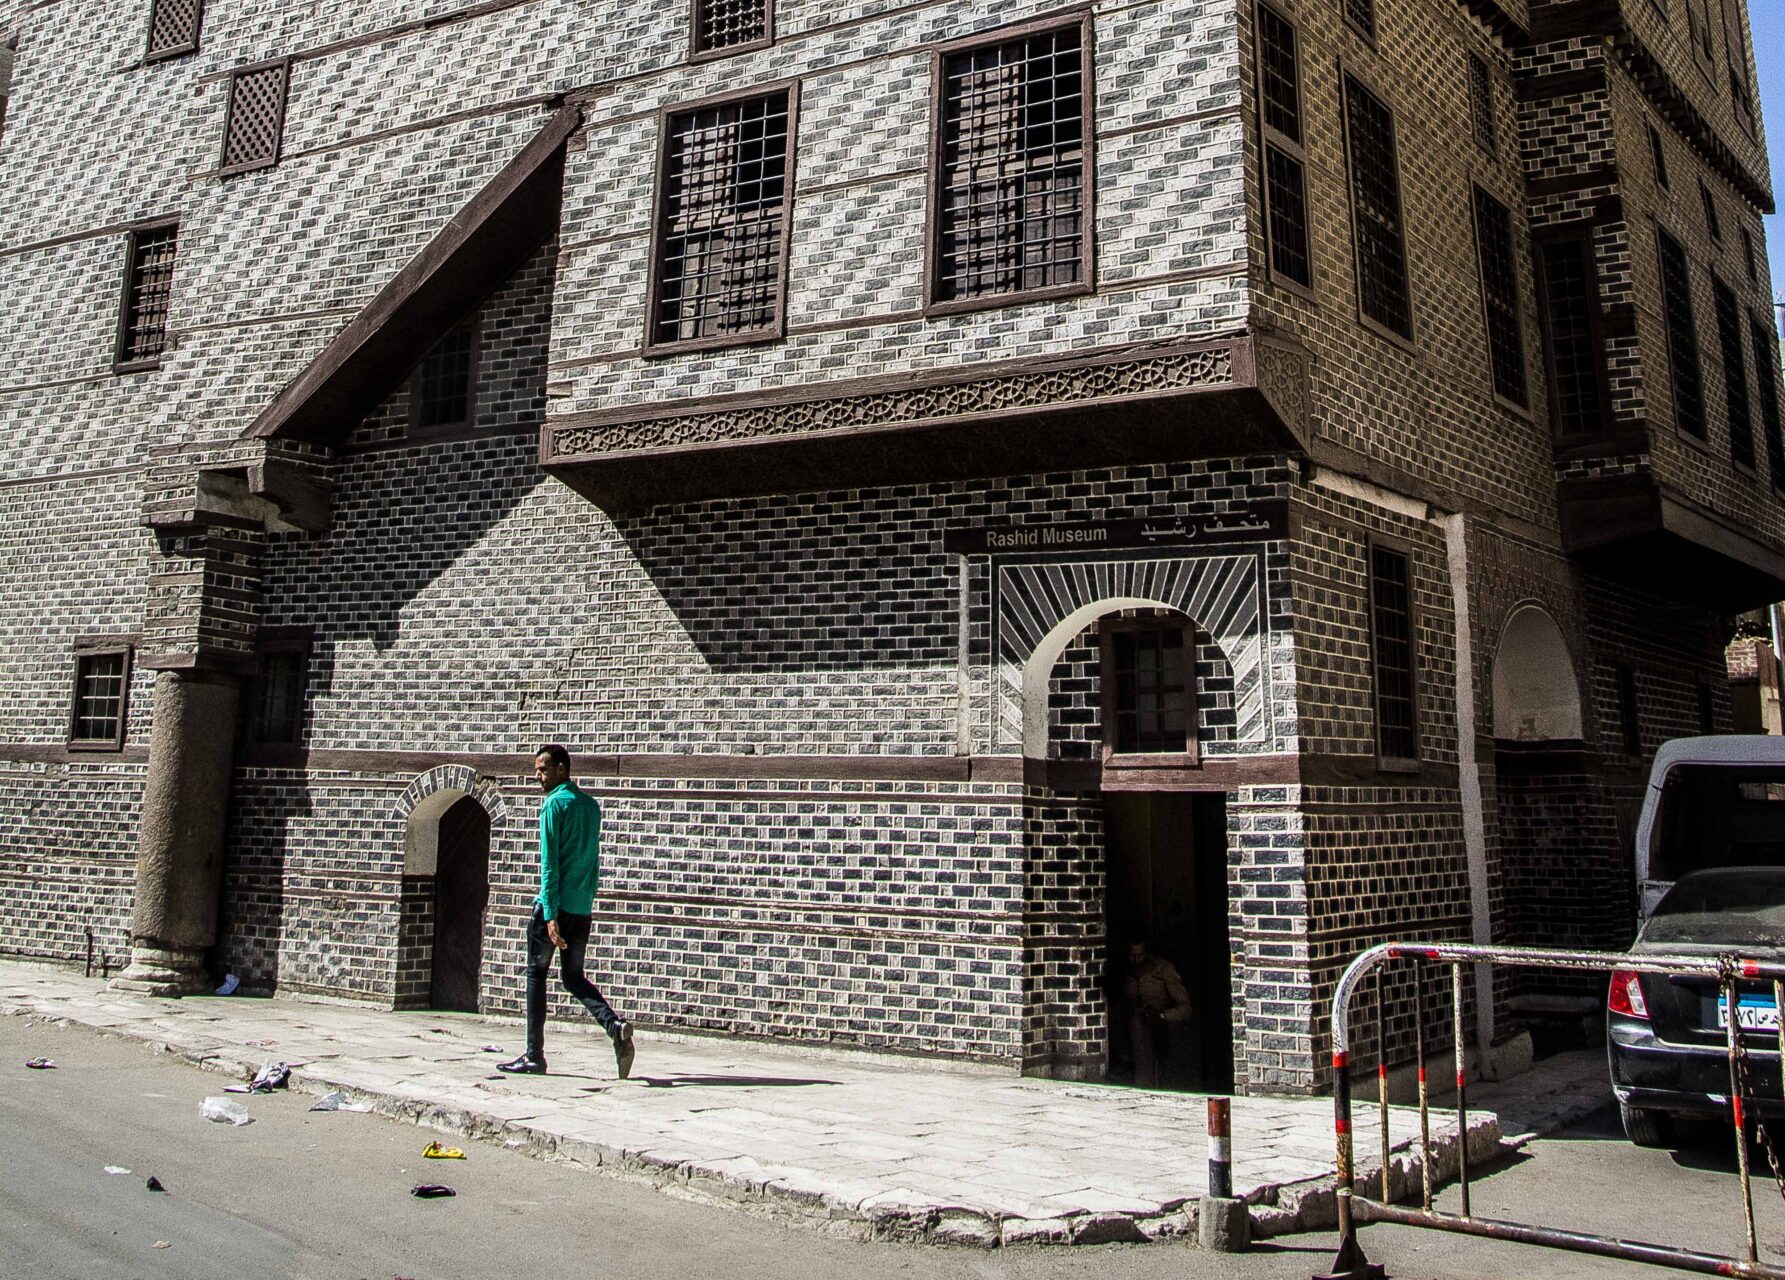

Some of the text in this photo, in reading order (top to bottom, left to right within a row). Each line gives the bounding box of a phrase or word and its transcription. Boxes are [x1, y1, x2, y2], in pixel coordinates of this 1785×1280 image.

[986, 527, 1108, 547] Rashid Museum
[1140, 514, 1270, 541] متحف رشيد
